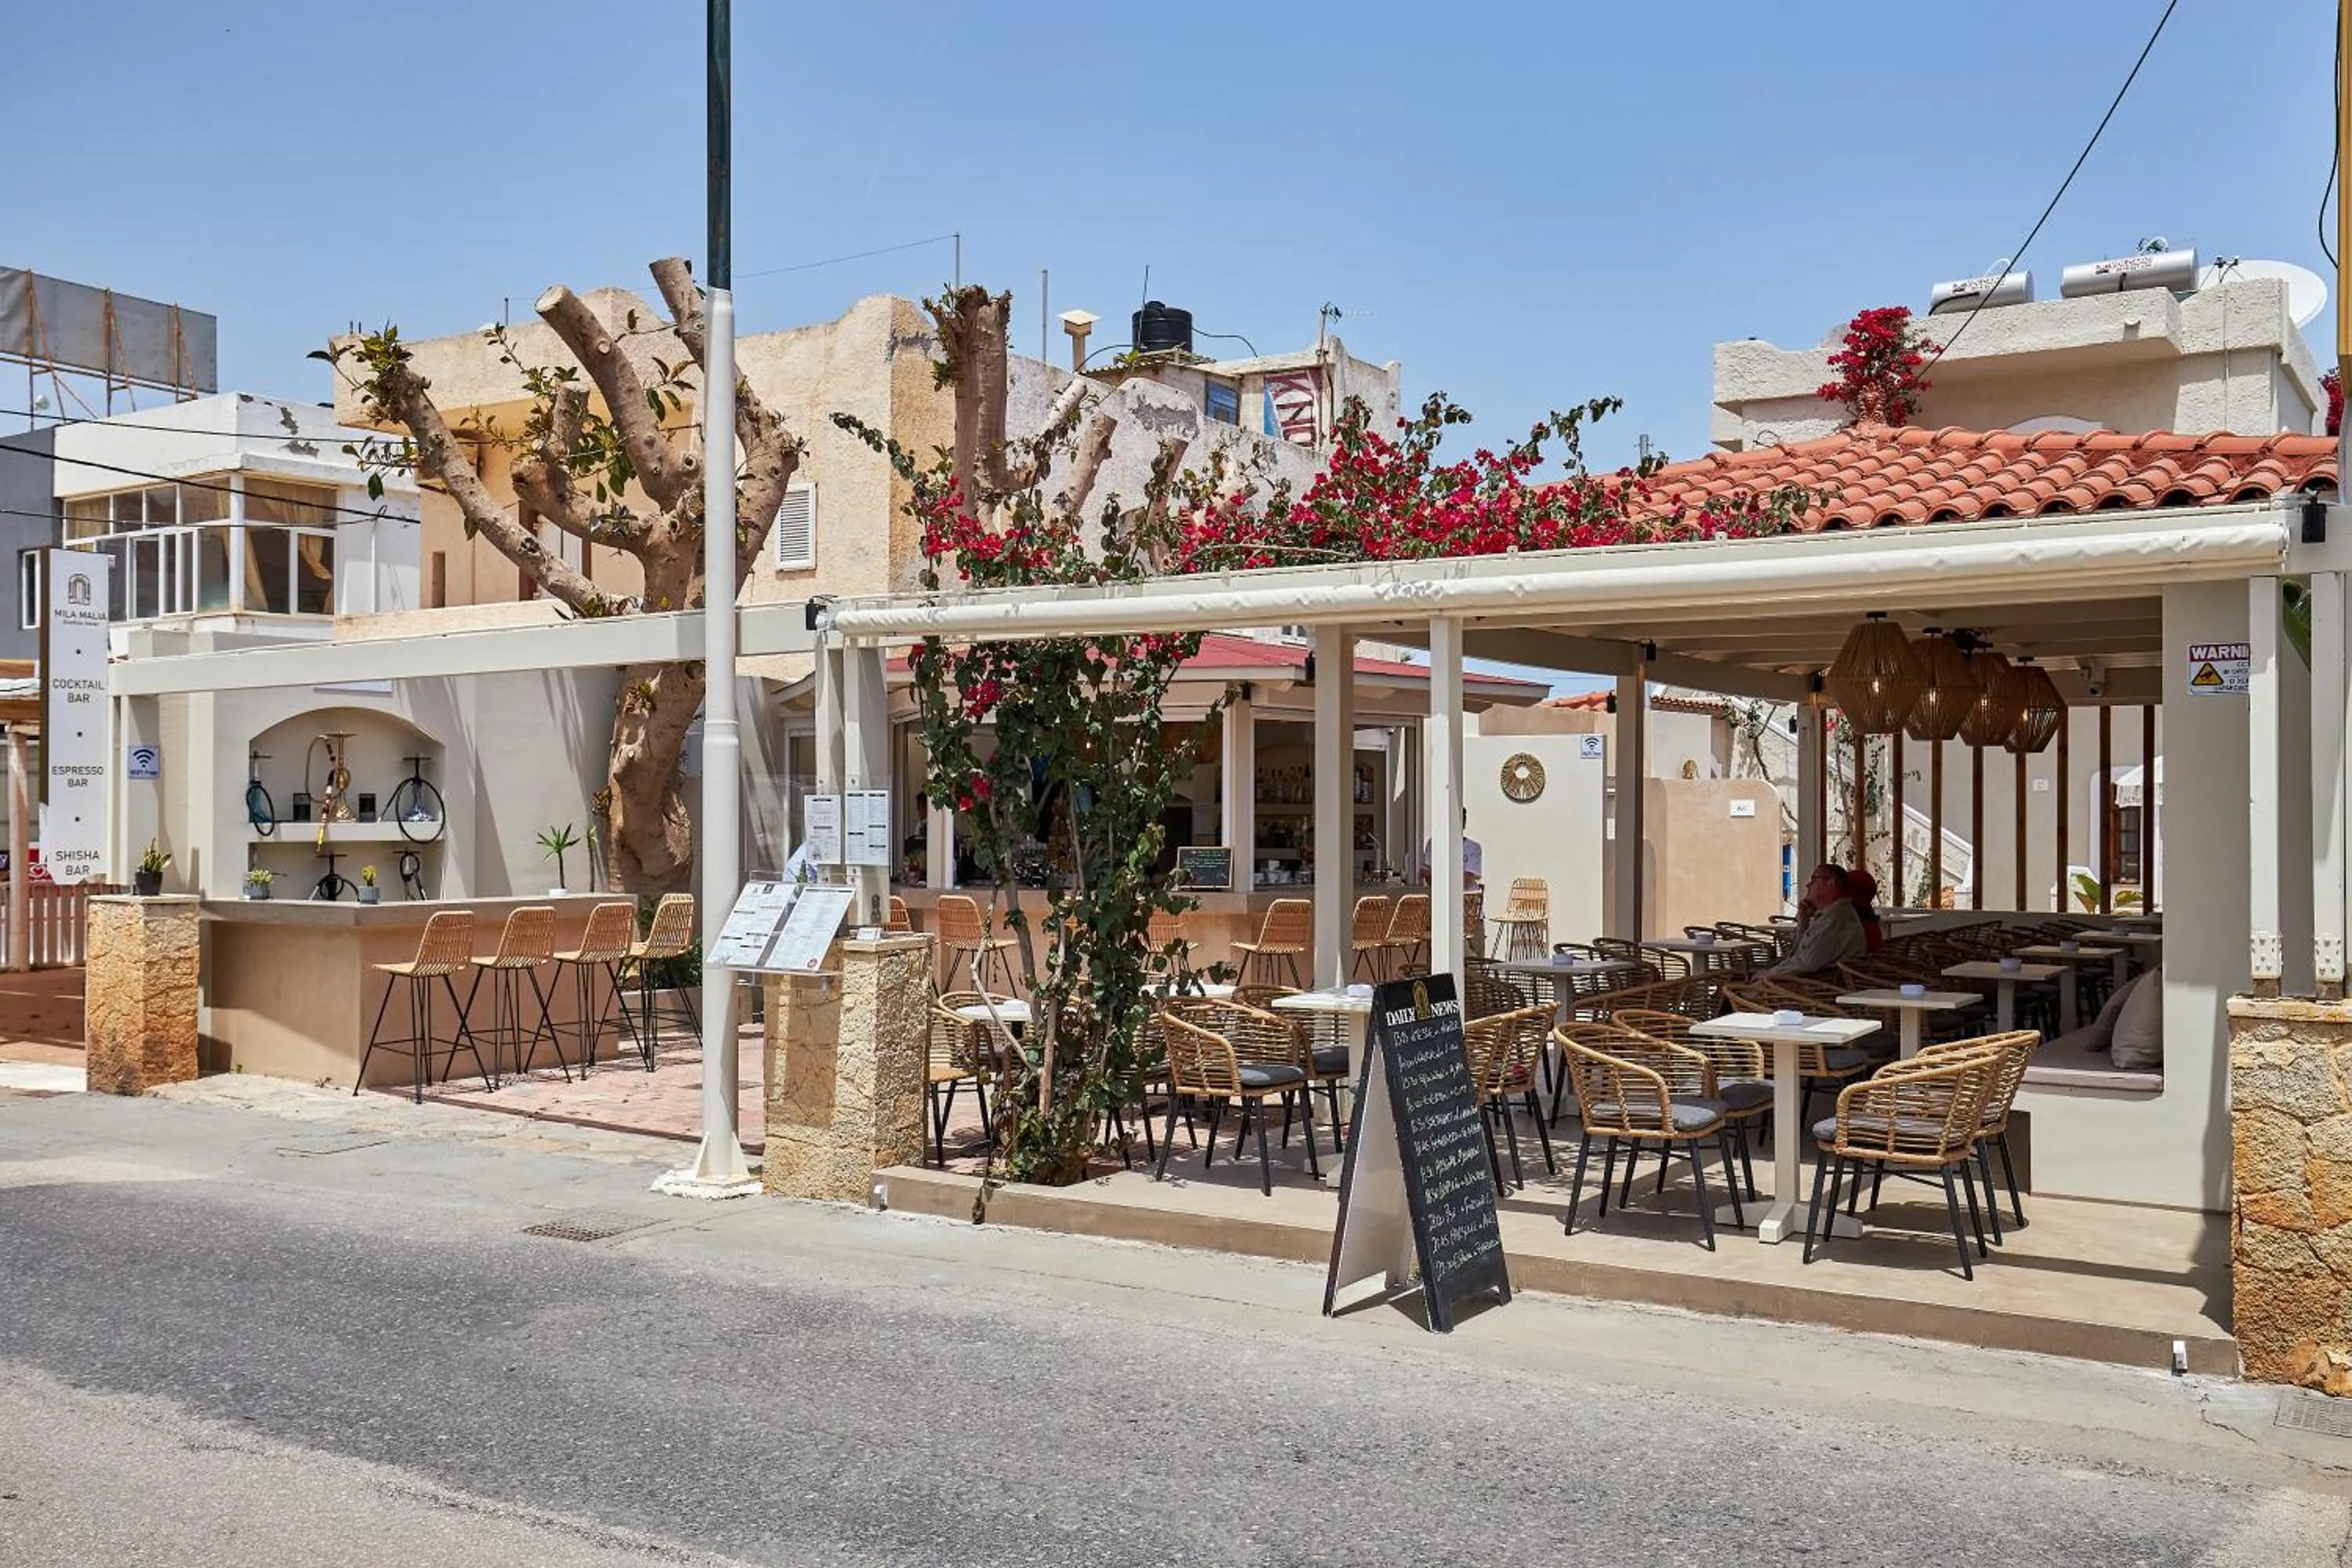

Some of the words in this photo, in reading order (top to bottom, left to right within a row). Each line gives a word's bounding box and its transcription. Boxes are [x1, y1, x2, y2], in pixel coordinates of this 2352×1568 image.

[54, 609, 76, 619] MILA
[79, 611, 107, 620] MALIA
[2191, 645, 2249, 660] WARNI
[53, 678, 105, 690] COCKTAIL
[67, 692, 90, 703] BAR
[52, 766, 104, 775] ESPRESSO
[67, 779, 89, 788] BAR
[56, 850, 100, 862] SHISHA
[65, 865, 90, 876] BAR
[1385, 1006, 1417, 1026] DAILY
[1429, 1000, 1461, 1019] NEWS
